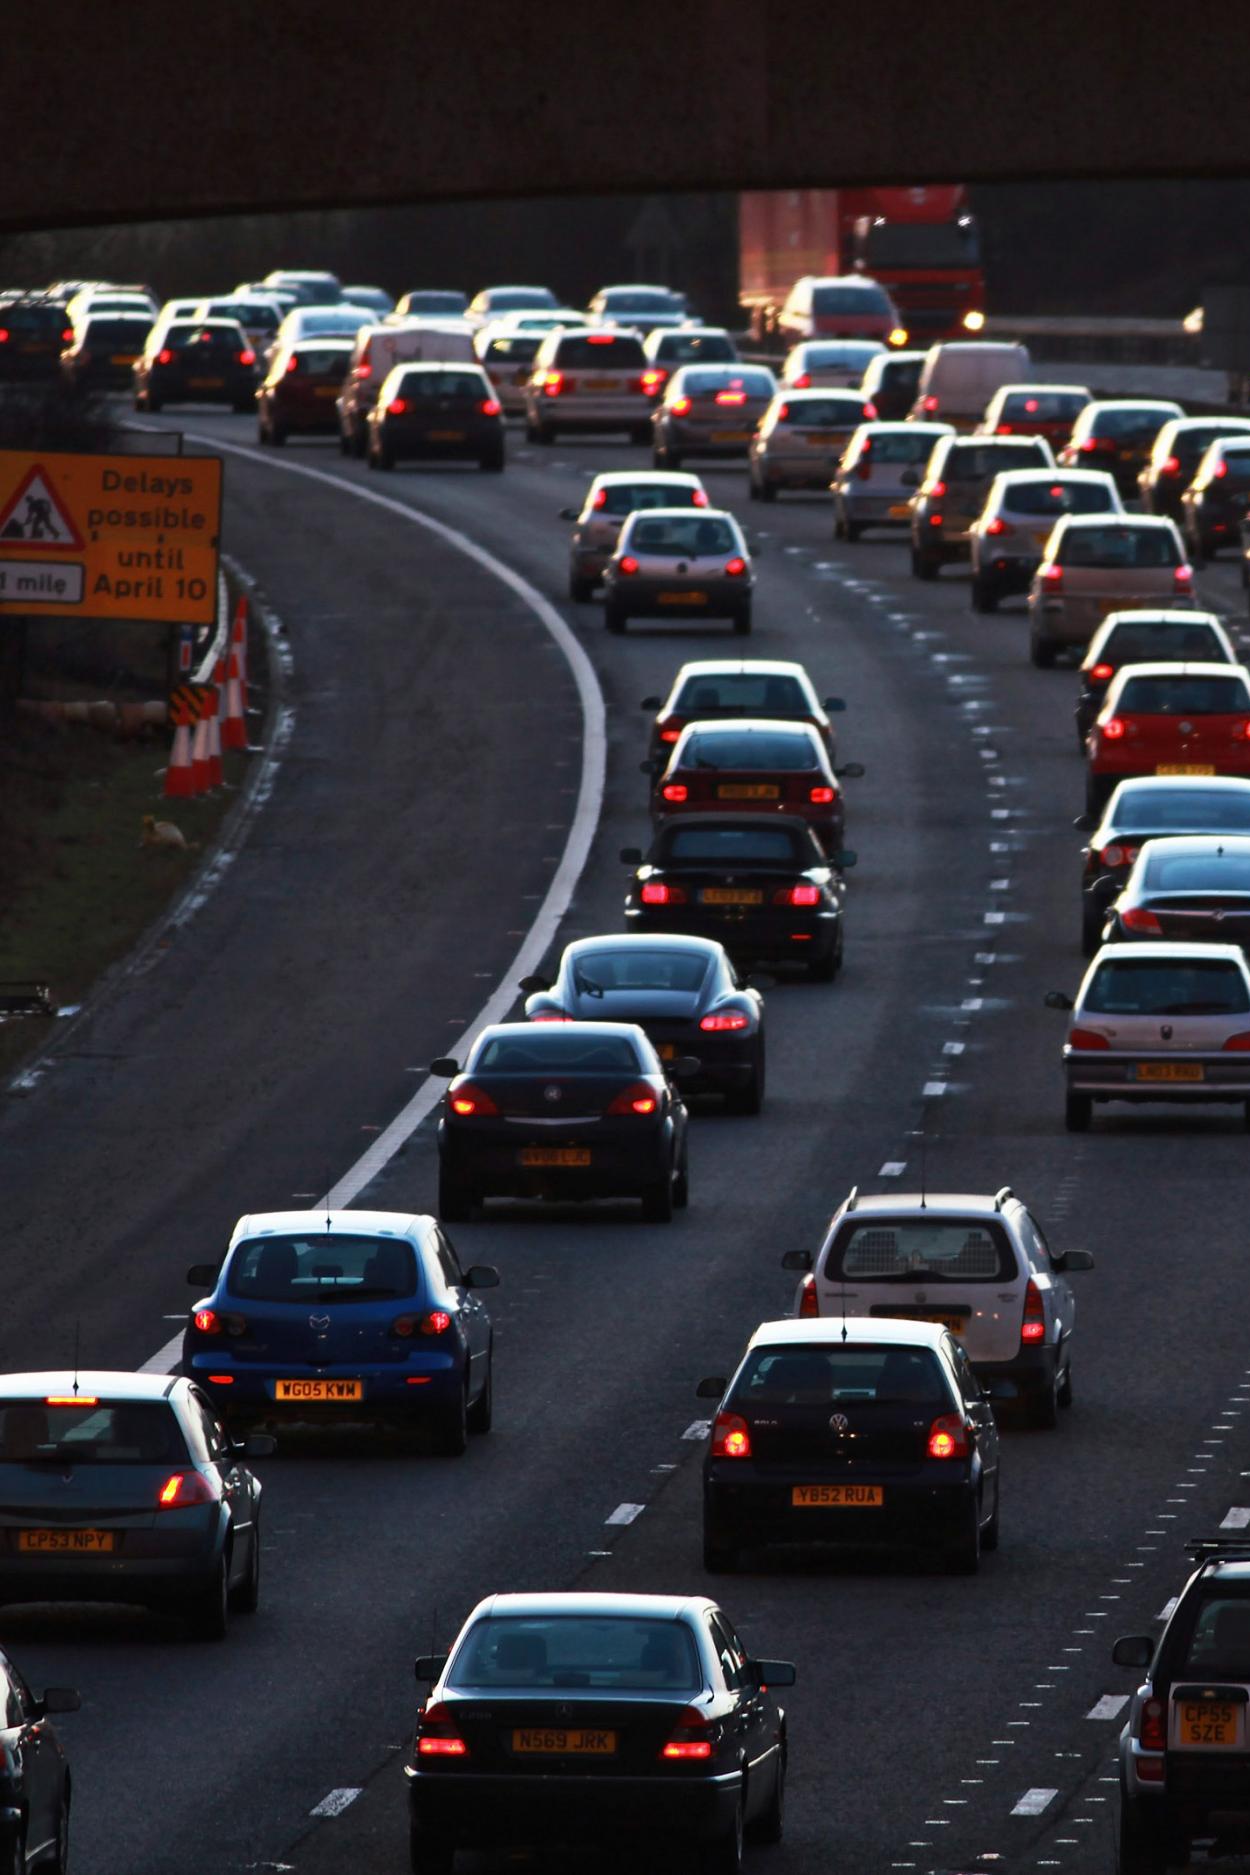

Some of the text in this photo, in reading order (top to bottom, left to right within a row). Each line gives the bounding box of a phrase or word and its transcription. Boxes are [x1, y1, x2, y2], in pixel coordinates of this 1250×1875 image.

[102, 470, 193, 497] Delays
[88, 509, 206, 529] possible
[118, 549, 184, 570] until
[17, 574, 66, 593] mile
[94, 574, 207, 600] April 10
[283, 1382, 321, 1396] WG05
[800, 1488, 875, 1502] YB52 RUA
[27, 1532, 104, 1548] CP53 NPY
[1185, 1702, 1231, 1722] CP55
[520, 1732, 609, 1750] N569 JRK
[1190, 1724, 1225, 1742] SZE
